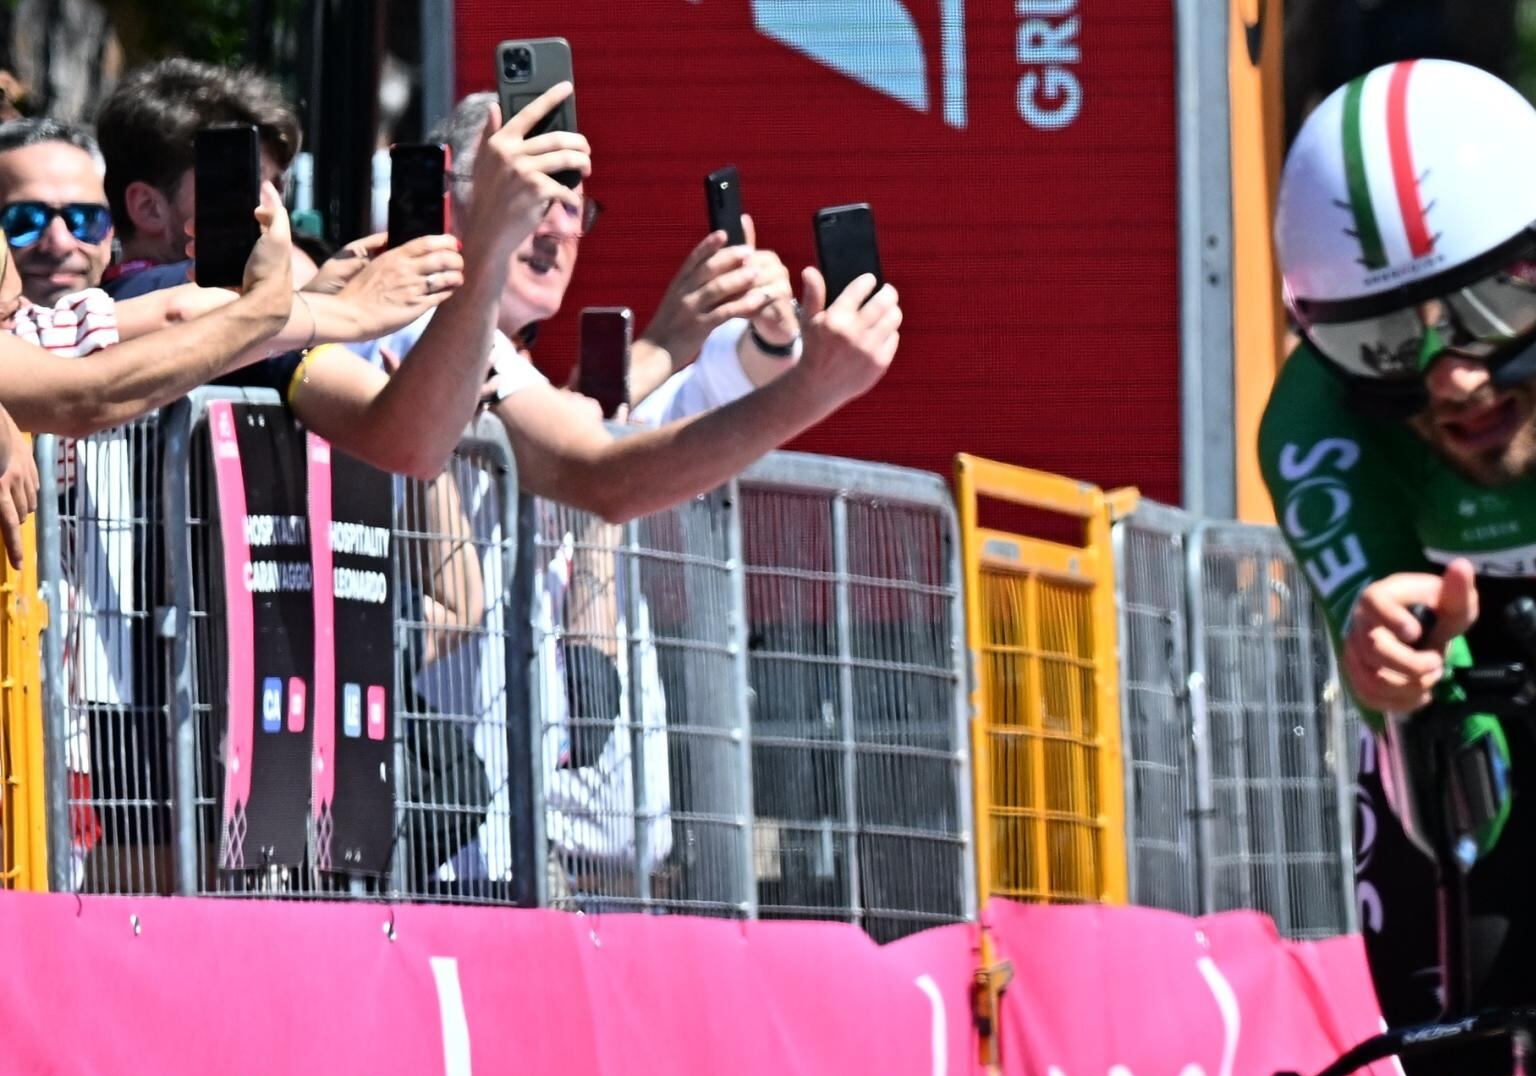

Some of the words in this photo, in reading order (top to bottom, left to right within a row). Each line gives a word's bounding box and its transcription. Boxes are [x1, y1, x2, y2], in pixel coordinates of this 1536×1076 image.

[1015, 0, 1083, 131] GR
[242, 514, 306, 546] HOSPITALITY
[1278, 436, 1369, 600] EOS
[327, 520, 390, 558] HOSPITALITY
[243, 560, 312, 592] CARAVAGGIO
[333, 567, 387, 604] LEONARDO
